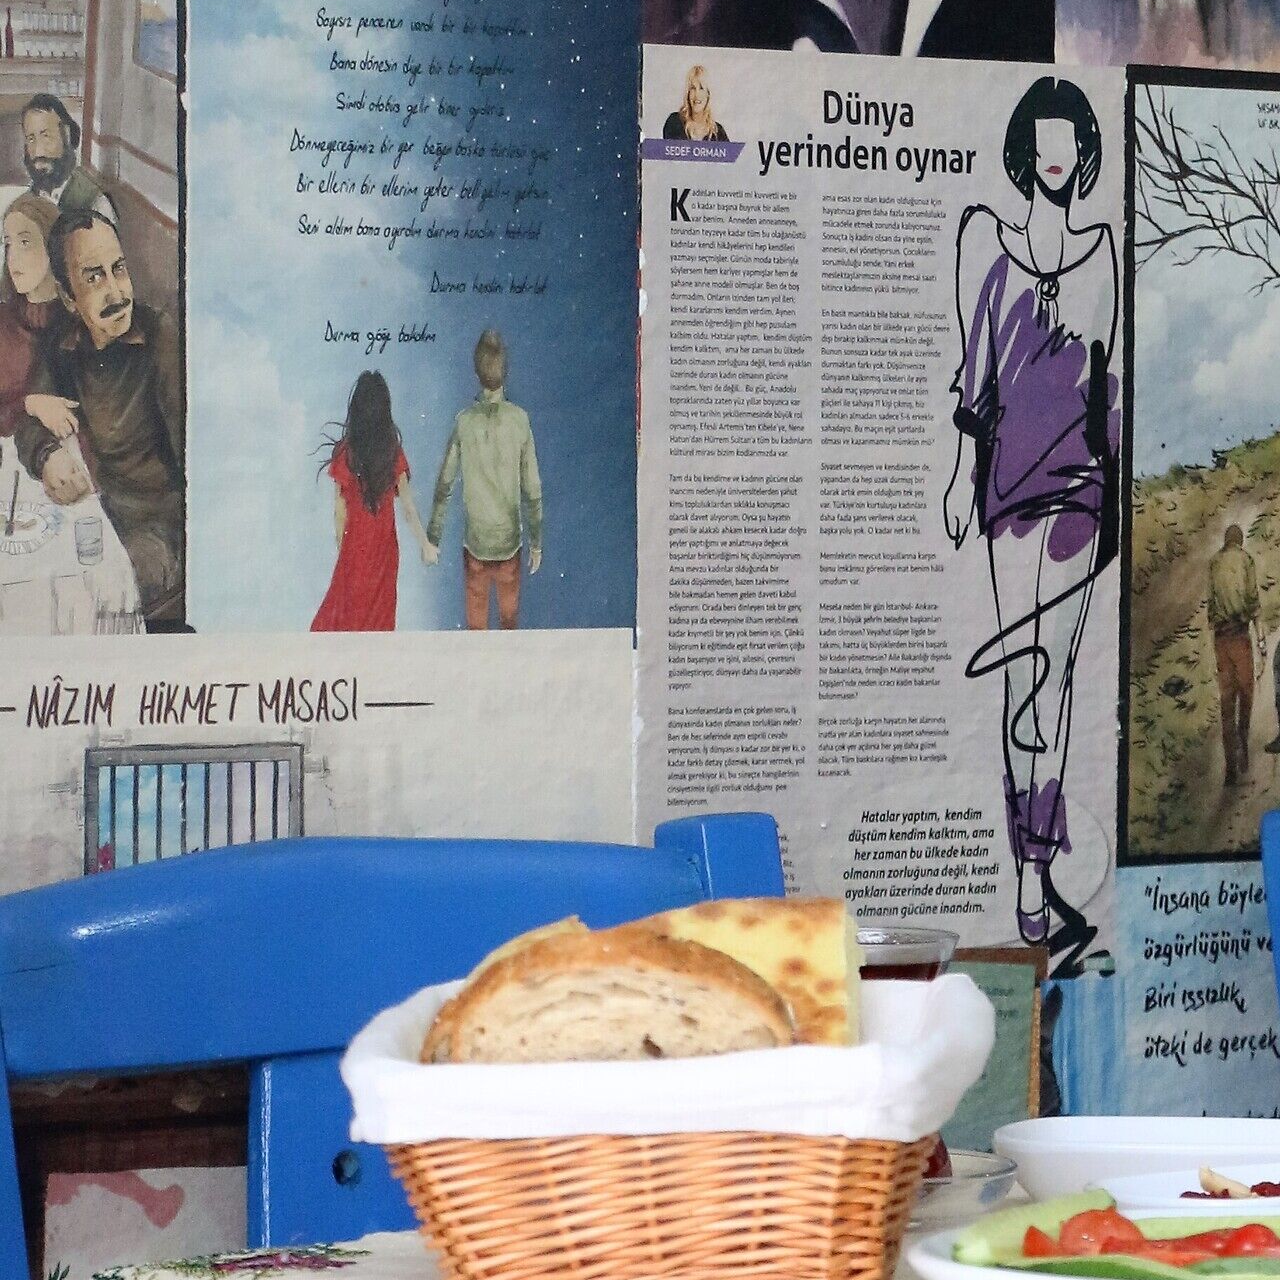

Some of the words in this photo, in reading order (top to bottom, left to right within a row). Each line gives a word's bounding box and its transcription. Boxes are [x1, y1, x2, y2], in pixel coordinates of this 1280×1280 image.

[824, 90, 914, 136] Dünya
[665, 146, 691, 156] SEDEF
[693, 147, 726, 158] ORMAN
[758, 134, 886, 176] yerinden
[896, 146, 976, 183] oynar
[324, 320, 360, 342] Durma
[26, 675, 115, 728] NÂZIM
[140, 682, 250, 726] HİKMET
[258, 677, 358, 725] MASASI
[862, 811, 901, 823] Hatalar
[902, 811, 940, 824] yaptım,
[945, 808, 981, 820] kendim
[849, 830, 886, 843] düştüm
[890, 829, 926, 841] kendim
[929, 828, 969, 840] kalktım,
[972, 829, 994, 838] ama
[855, 849, 872, 860] her
[873, 850, 906, 859] zaman
[910, 847, 922, 859] bu
[925, 847, 958, 858] ülkede
[961, 846, 988, 857] kadın
[843, 868, 886, 880] olmanın
[887, 866, 939, 880] zorluğuna
[942, 864, 968, 879] değil,
[972, 864, 999, 875] kendi
[845, 886, 887, 900] ayakları
[890, 884, 933, 896] üzerinde
[936, 883, 965, 895] duran
[968, 882, 996, 894] kadın
[857, 905, 898, 916] olmanın
[901, 904, 938, 918] gücüne
[940, 902, 985, 913] inandım.
[1144, 929, 1251, 967] özgürlüğünü
[1145, 982, 1177, 1012] Biri
[1145, 1030, 1187, 1067] öteki
[1193, 1032, 1212, 1054] de
